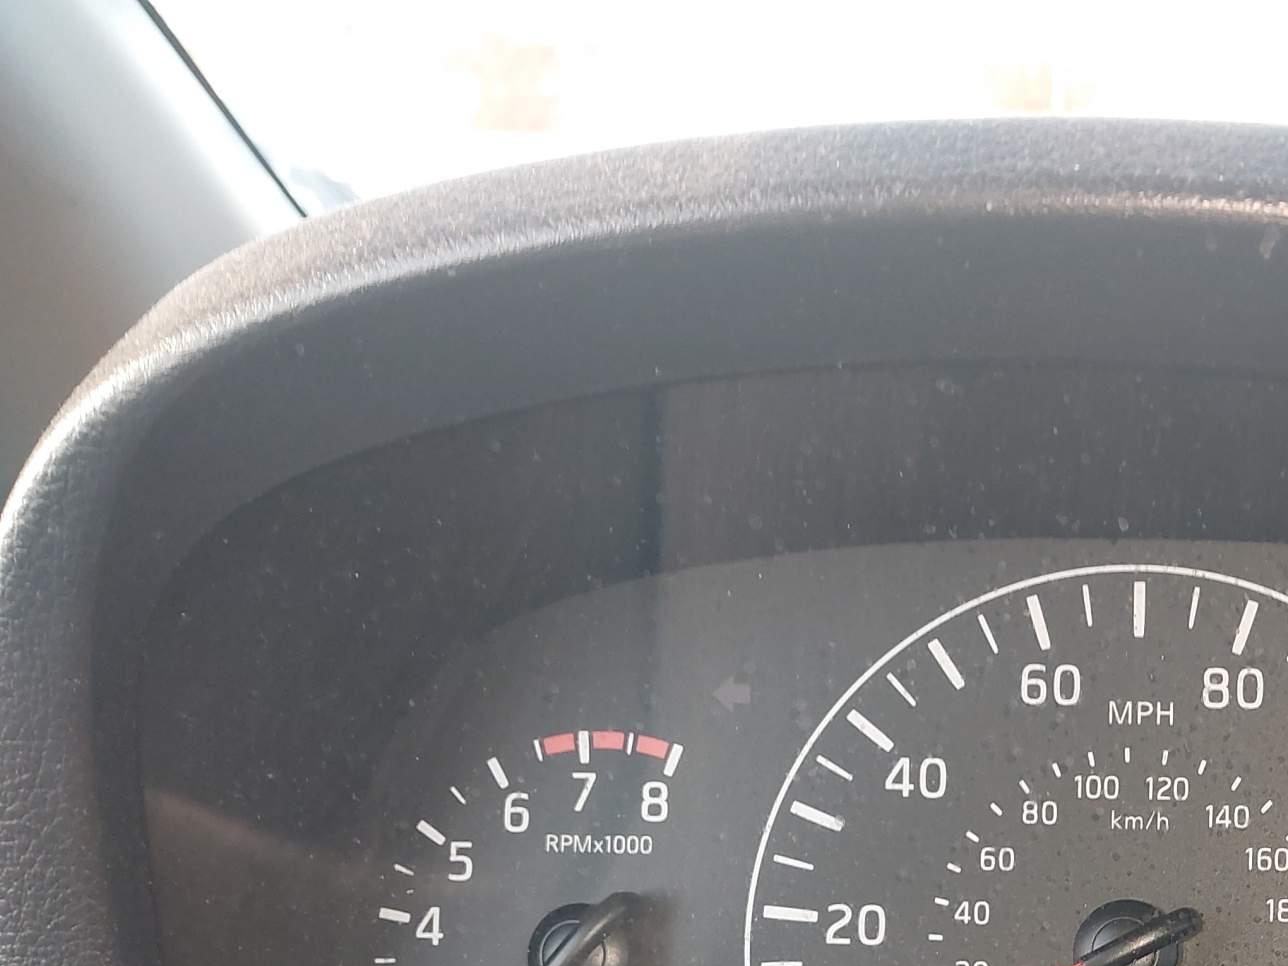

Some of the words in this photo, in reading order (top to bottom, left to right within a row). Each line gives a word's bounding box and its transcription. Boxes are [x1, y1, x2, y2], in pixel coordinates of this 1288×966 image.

[1020, 664, 1081, 705] 60
[1202, 667, 1264, 710] 80
[1108, 700, 1174, 726] MPH
[571, 772, 597, 811] 7
[885, 757, 947, 799] 40
[1074, 775, 1119, 800] 100
[1146, 777, 1189, 801] 120
[504, 792, 530, 833] 6
[641, 781, 669, 823] 8
[1022, 801, 1058, 825] 80
[1205, 805, 1250, 829] 140
[1111, 809, 1170, 831] km/h
[545, 834, 653, 856] RPMx1000
[980, 847, 1015, 872] 60
[448, 841, 474, 882] 5
[416, 906, 444, 946] 4
[825, 903, 886, 946] 20
[954, 901, 990, 925] 40
